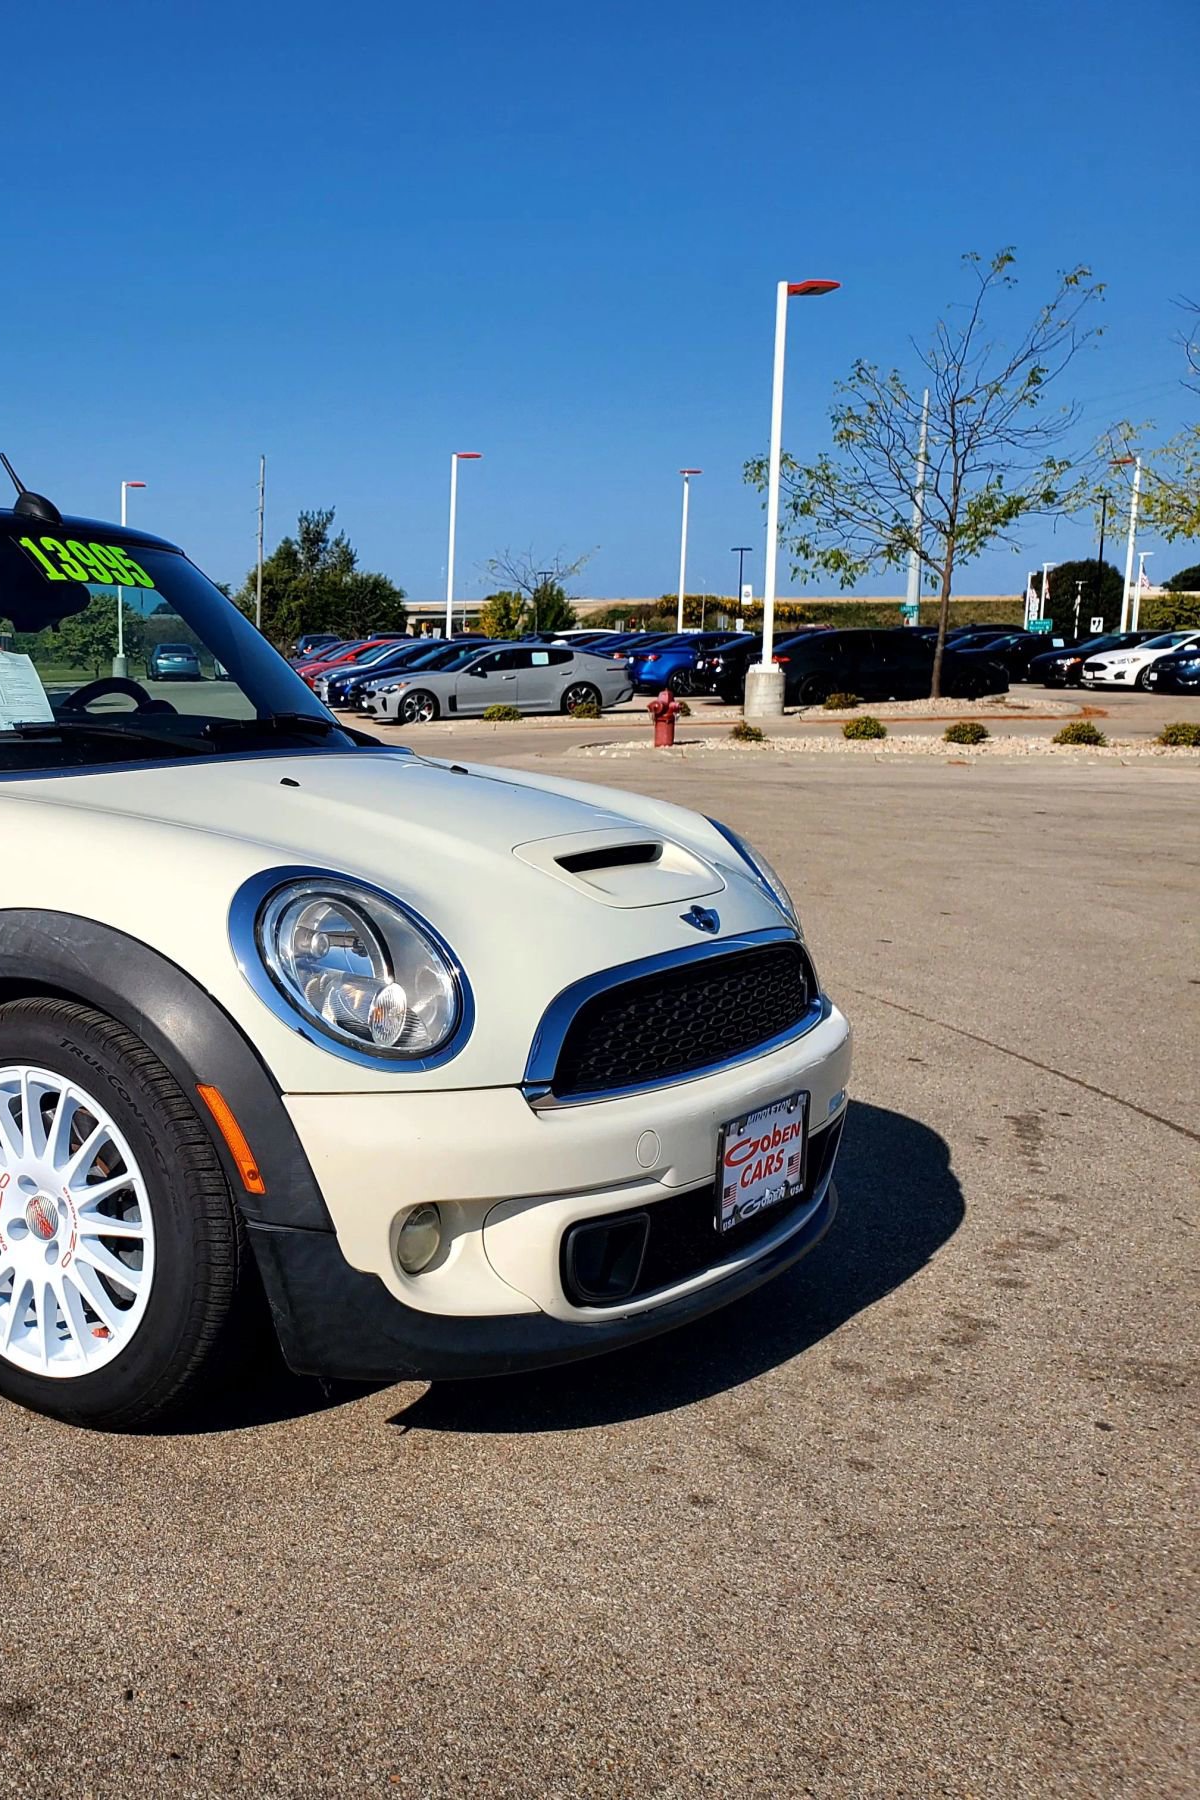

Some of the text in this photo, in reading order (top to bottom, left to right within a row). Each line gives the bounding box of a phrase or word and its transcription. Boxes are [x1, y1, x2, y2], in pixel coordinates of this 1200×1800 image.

[19, 536, 155, 588] 13995
[740, 1148, 785, 1188] CARS
[722, 1217, 736, 1231] USA
